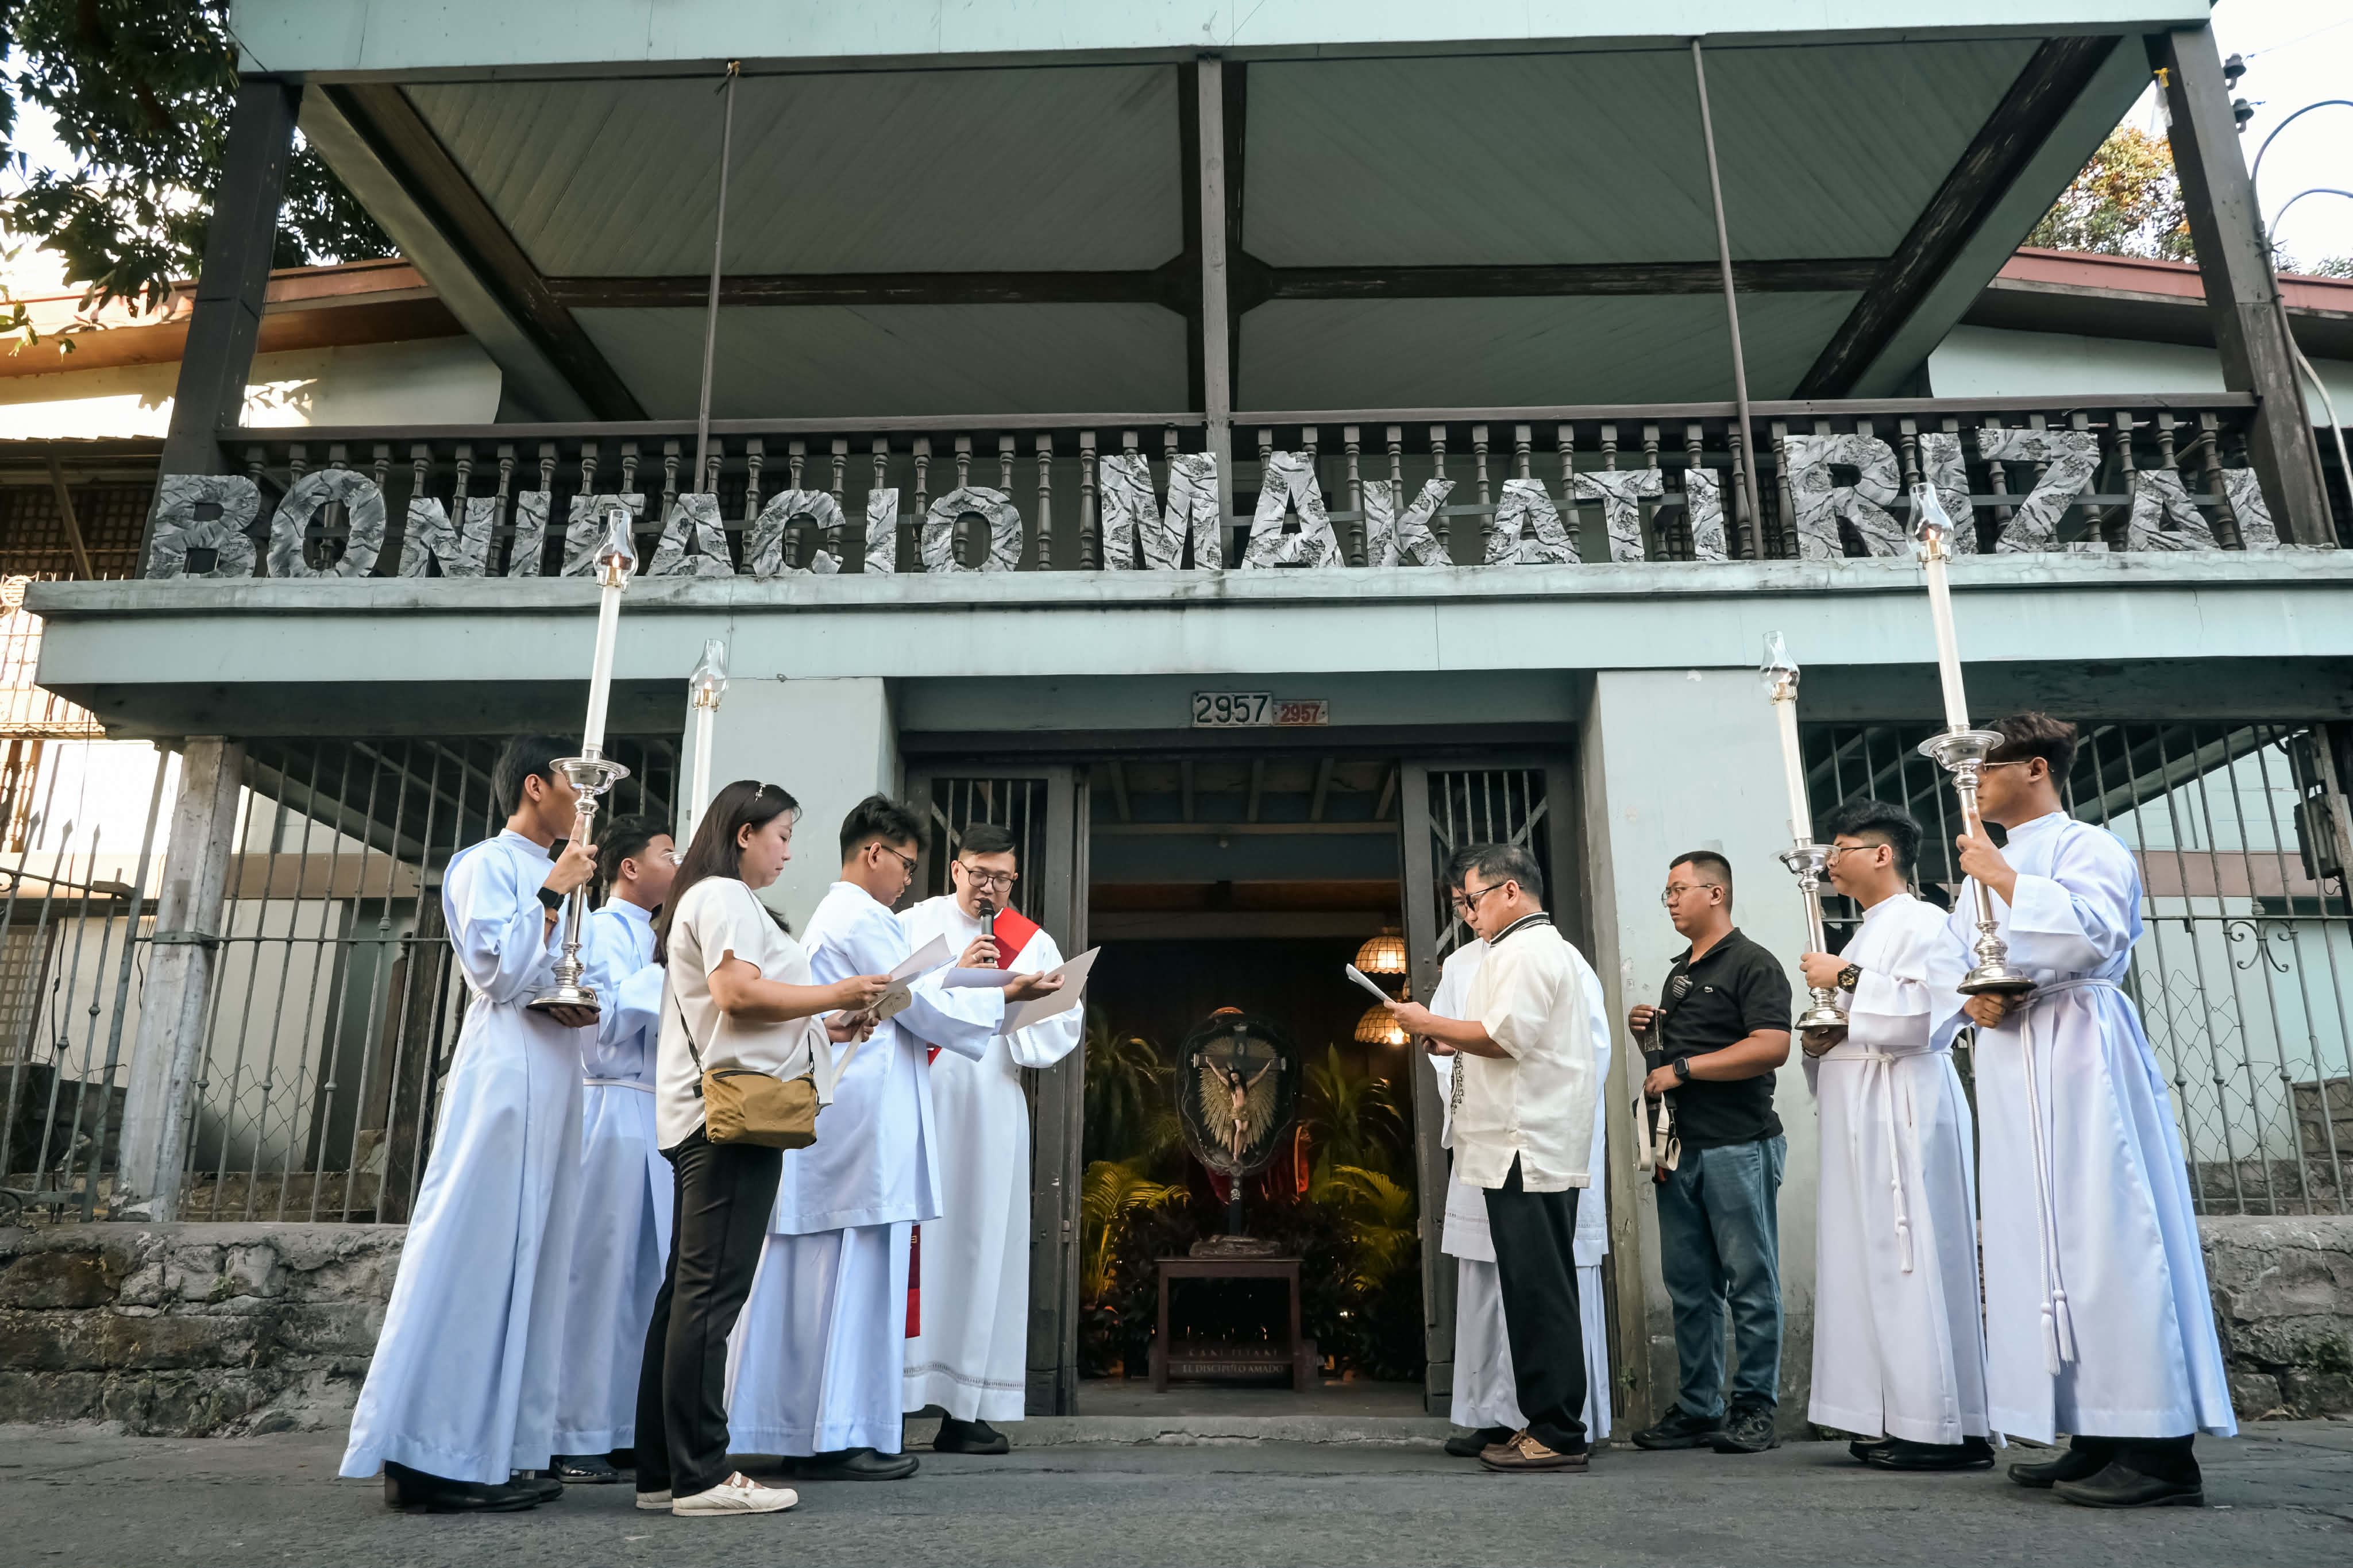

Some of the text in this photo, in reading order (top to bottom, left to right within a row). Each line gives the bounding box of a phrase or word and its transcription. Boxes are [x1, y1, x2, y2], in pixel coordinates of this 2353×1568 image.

[145, 428, 2336, 580] BONIFACIO MAKATI RIZAL
[1196, 695, 1268, 723] 2957
[1280, 704, 1321, 722] 2957
[1248, 1364, 1283, 1373] AMADO
